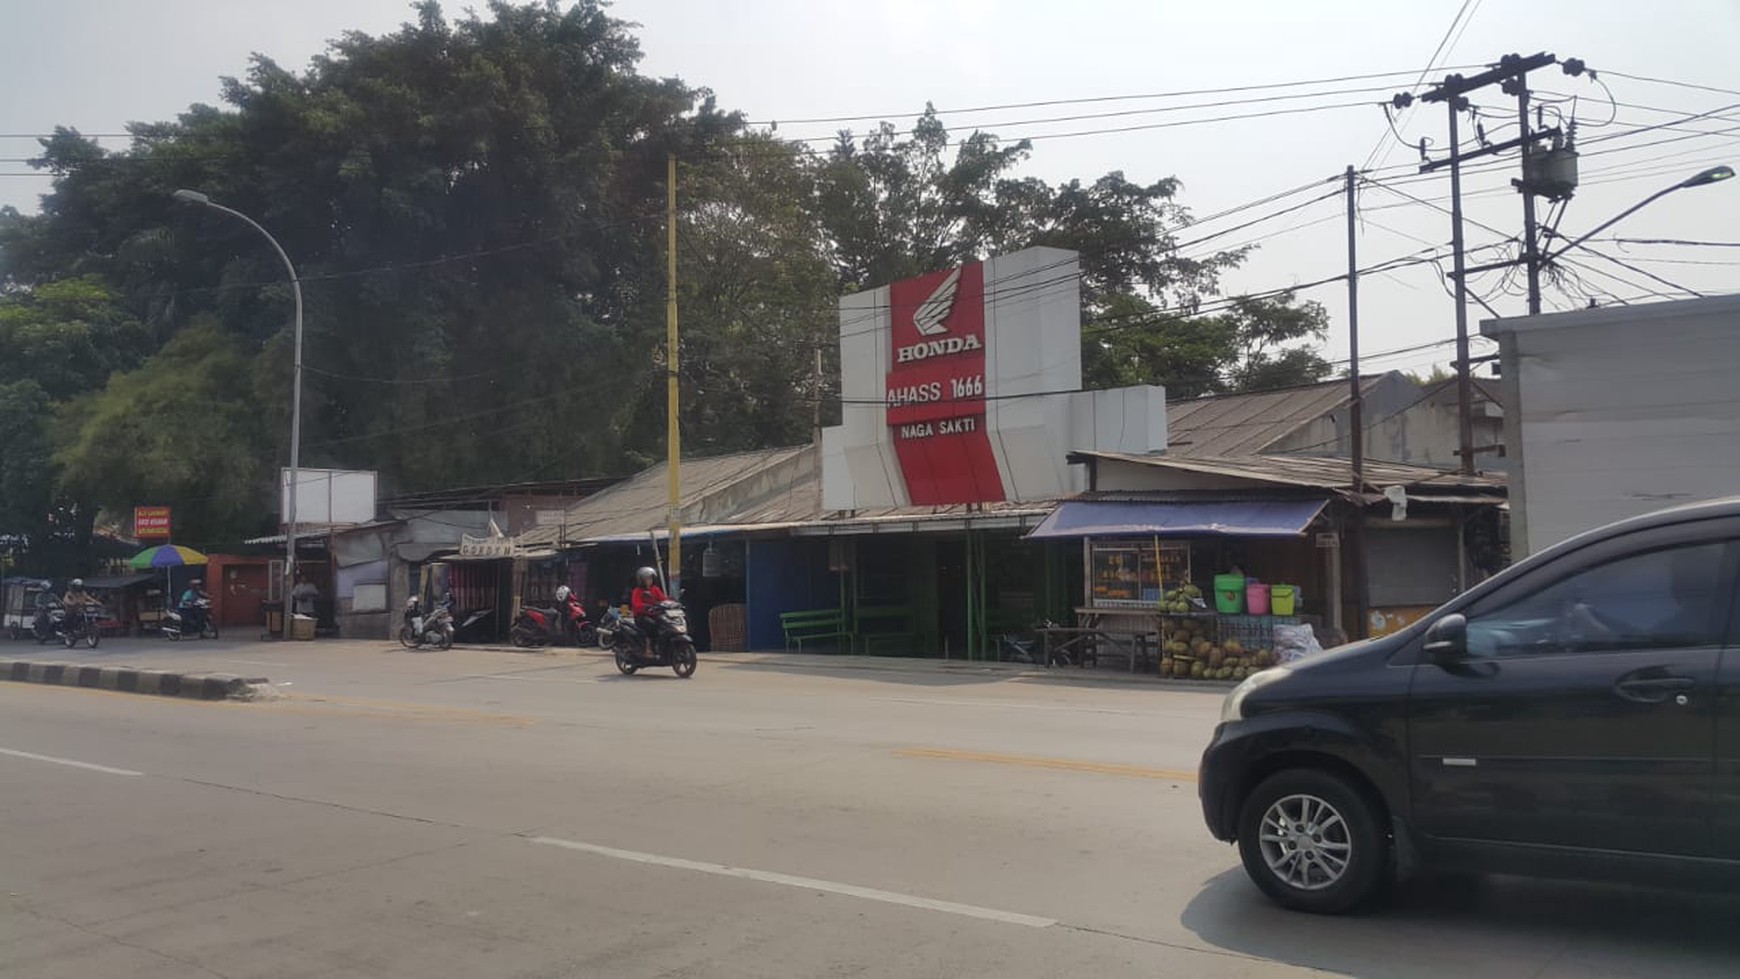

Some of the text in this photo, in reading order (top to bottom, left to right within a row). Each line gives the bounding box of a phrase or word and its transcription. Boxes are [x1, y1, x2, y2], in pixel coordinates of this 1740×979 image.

[898, 335, 982, 362] HONDA
[887, 375, 983, 409] AHASS 1666
[902, 418, 975, 439] NAGA SAKTI
